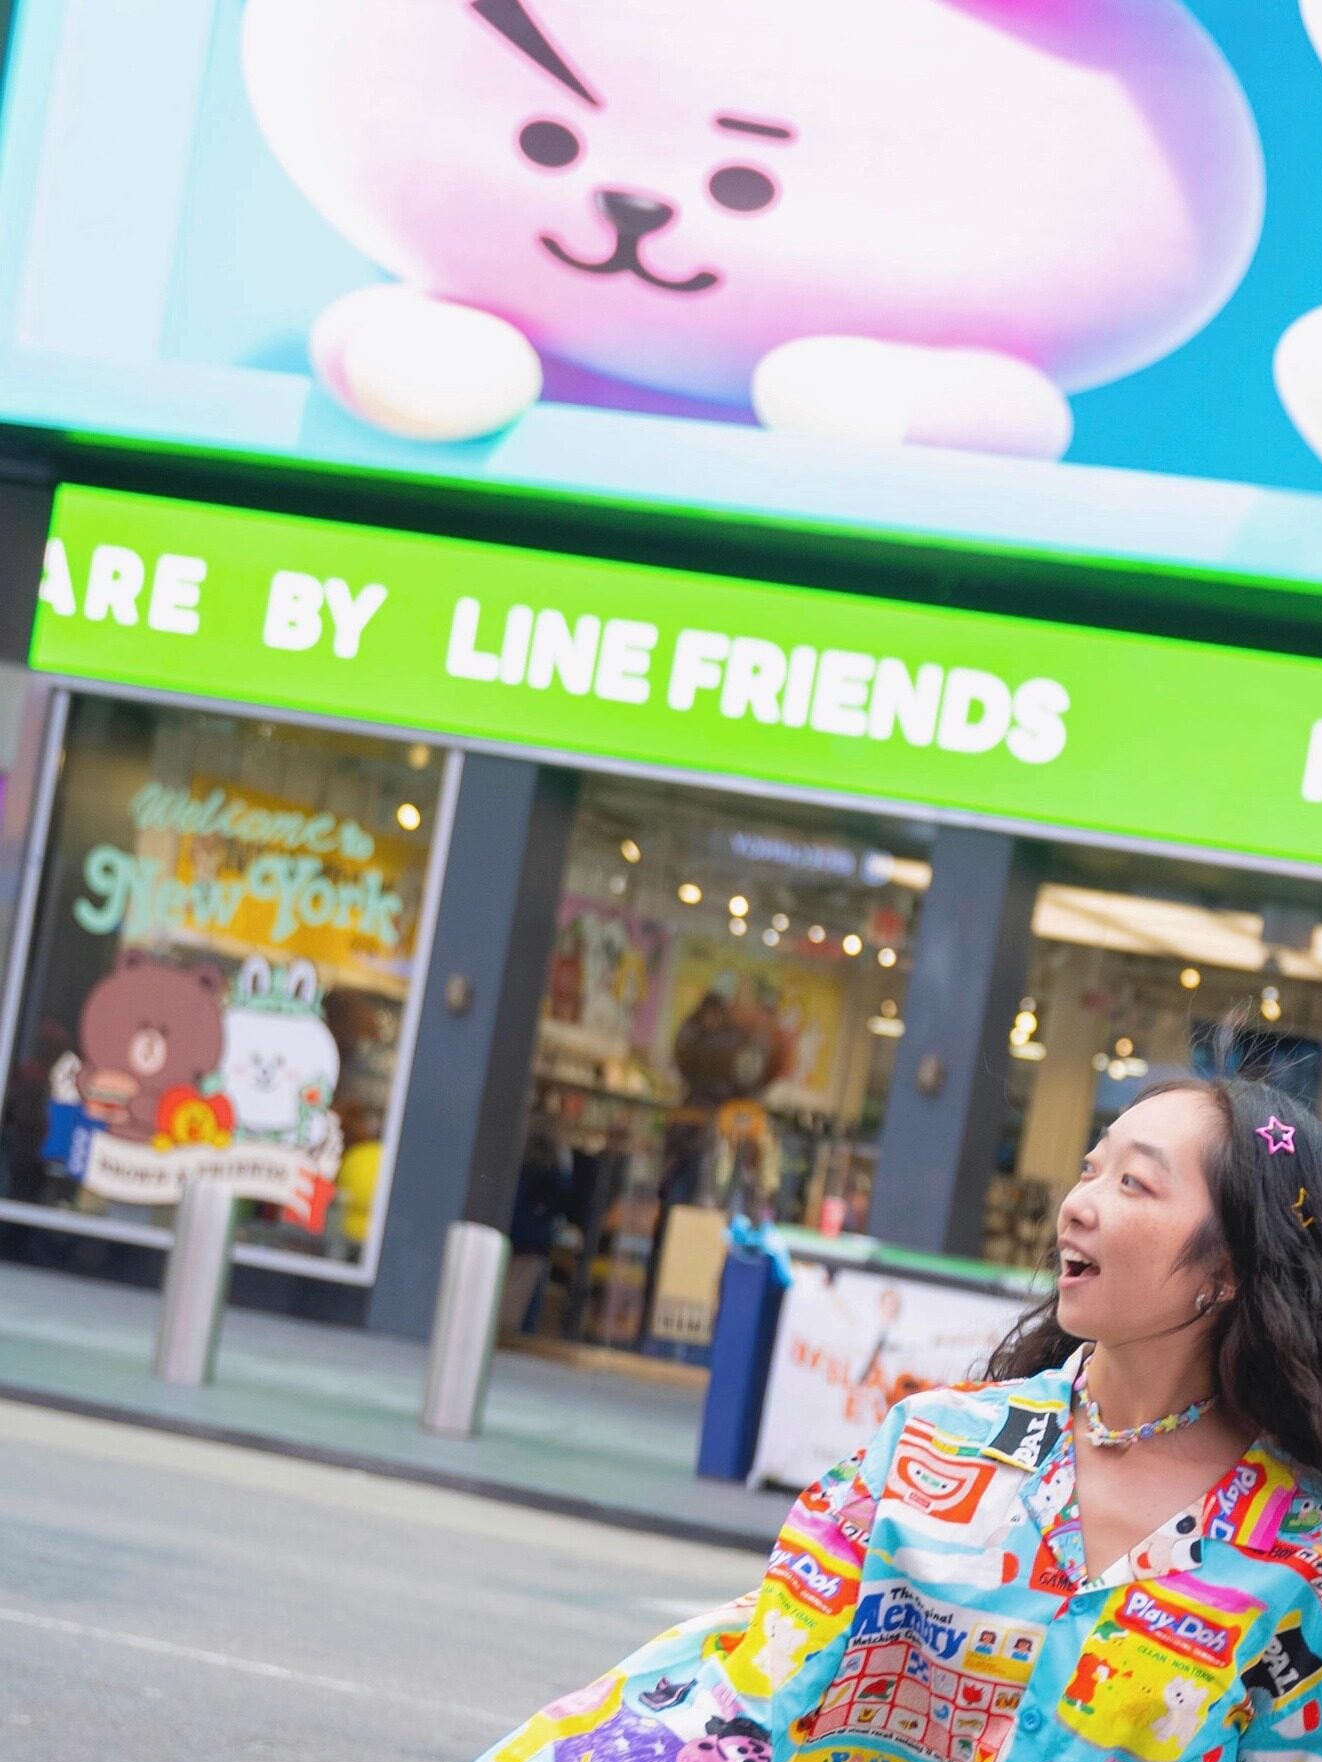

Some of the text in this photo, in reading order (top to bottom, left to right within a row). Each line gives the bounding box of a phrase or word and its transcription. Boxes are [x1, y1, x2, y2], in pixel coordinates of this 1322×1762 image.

[262, 571, 387, 661] BY
[445, 596, 661, 706] LINE
[667, 629, 1072, 766] FRIENDS
[132, 783, 337, 853] Welcome
[73, 844, 403, 946] New York
